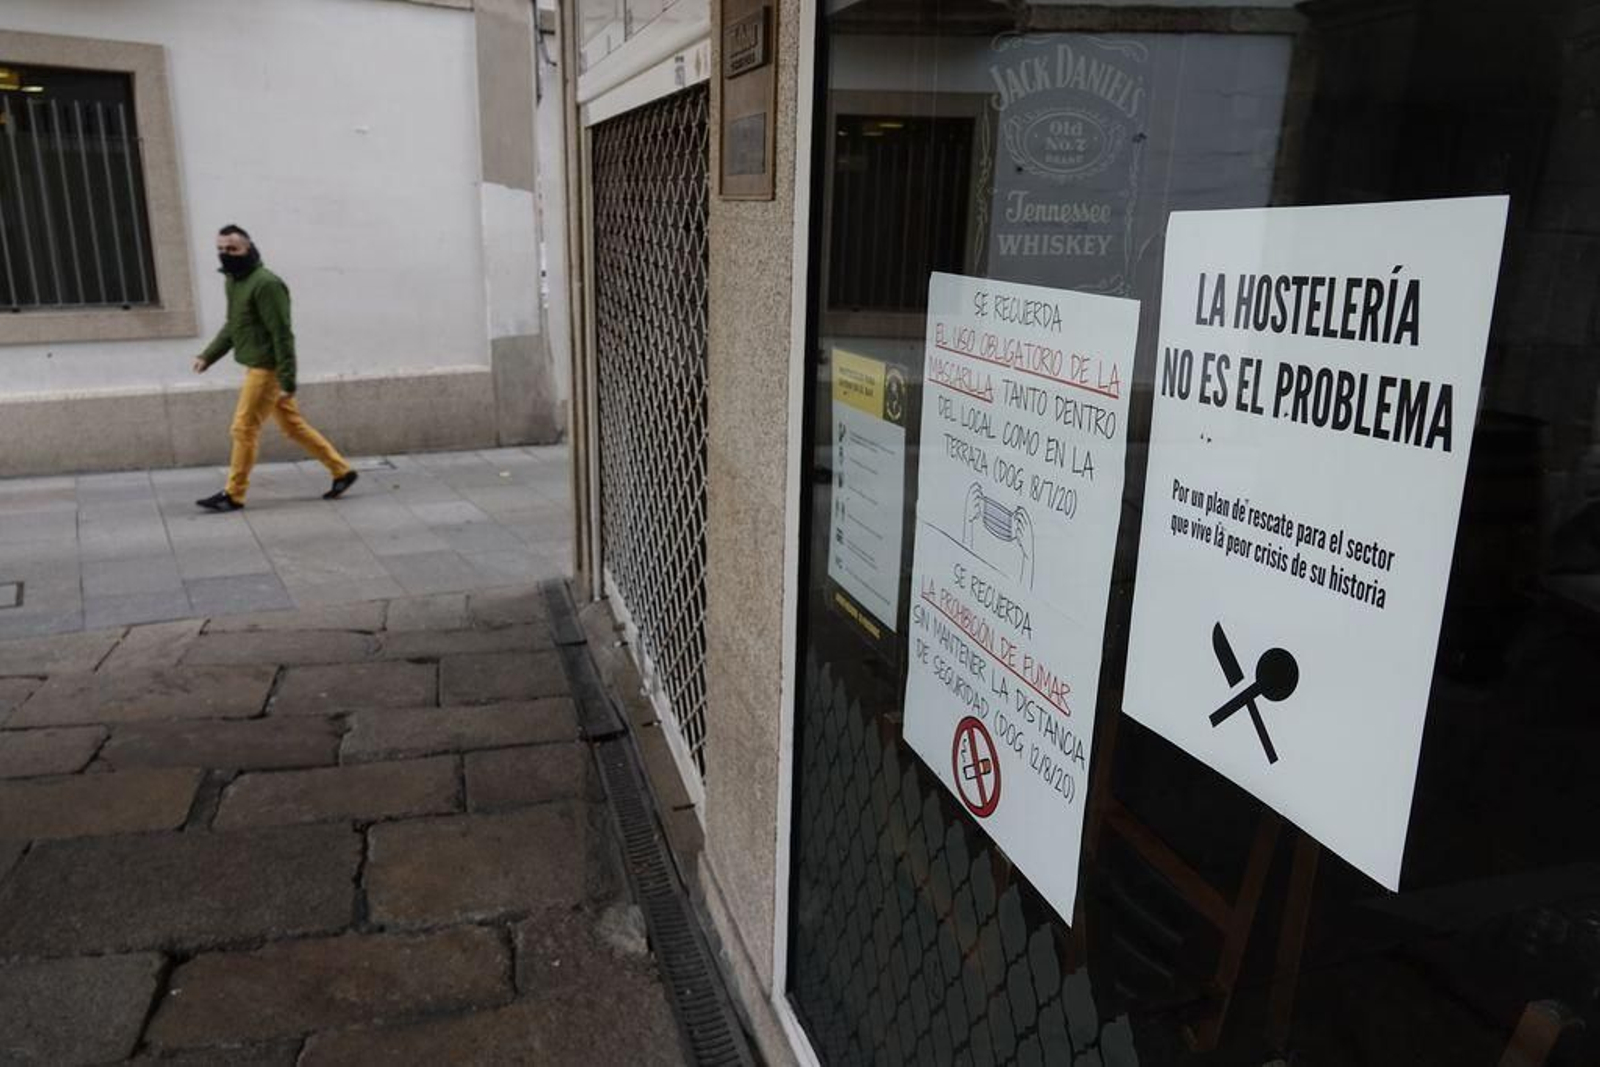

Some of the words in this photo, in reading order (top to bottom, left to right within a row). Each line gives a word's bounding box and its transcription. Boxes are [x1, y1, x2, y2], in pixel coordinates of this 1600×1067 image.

[990, 55, 1050, 111] JACK
[1049, 120, 1083, 137] Old
[1005, 190, 1112, 223] Tennessee
[997, 234, 1113, 256] WHISKEY
[974, 291, 988, 317] SE
[994, 294, 1063, 333] RECUERDA
[1195, 272, 1226, 327] LA
[1233, 265, 1420, 346] HOSTELERÍA
[936, 322, 948, 346] EL
[953, 325, 976, 351] USO
[980, 332, 1063, 377] OBLIGATORIO
[1071, 354, 1090, 384] DE
[1098, 357, 1120, 397] LA
[938, 394, 957, 422] DEL
[961, 404, 996, 438] LOCAL
[1003, 422, 1040, 457] COMO
[1045, 436, 1066, 468] EN
[1072, 445, 1094, 481] LA
[1002, 379, 1048, 416] TANTO
[1055, 396, 1117, 439] DENTRO
[1161, 347, 1194, 400] NO
[1199, 352, 1230, 408] ES
[1236, 357, 1264, 415] EL
[1272, 362, 1453, 453] PROBLEMA
[944, 433, 988, 476] TERRAZA
[1171, 514, 1189, 536] que
[1191, 518, 1212, 544] vive
[1213, 523, 1225, 548] la
[1226, 533, 1252, 558] peor
[1254, 542, 1288, 573] crisis
[1291, 552, 1307, 579] de
[1309, 563, 1326, 587] su
[1329, 564, 1386, 610] historia
[1172, 478, 1190, 503] Por
[1191, 487, 1204, 508] un
[1205, 491, 1229, 518] plan
[1232, 497, 1247, 523] de
[1248, 506, 1294, 539] rescate
[1296, 522, 1326, 550] para
[1329, 529, 1344, 555] el
[1346, 537, 1395, 572] sector
[953, 563, 967, 589] SE
[971, 575, 1033, 640] RECUERDA
[916, 638, 930, 665] DE
[921, 574, 936, 597] LA
[1001, 636, 1018, 668] DE
[1023, 653, 1072, 709] FUMAR
[912, 603, 931, 632] SIN
[933, 616, 987, 684] MANTENER
[992, 668, 1009, 703] LA
[1017, 688, 1085, 771] DISTANCIA
